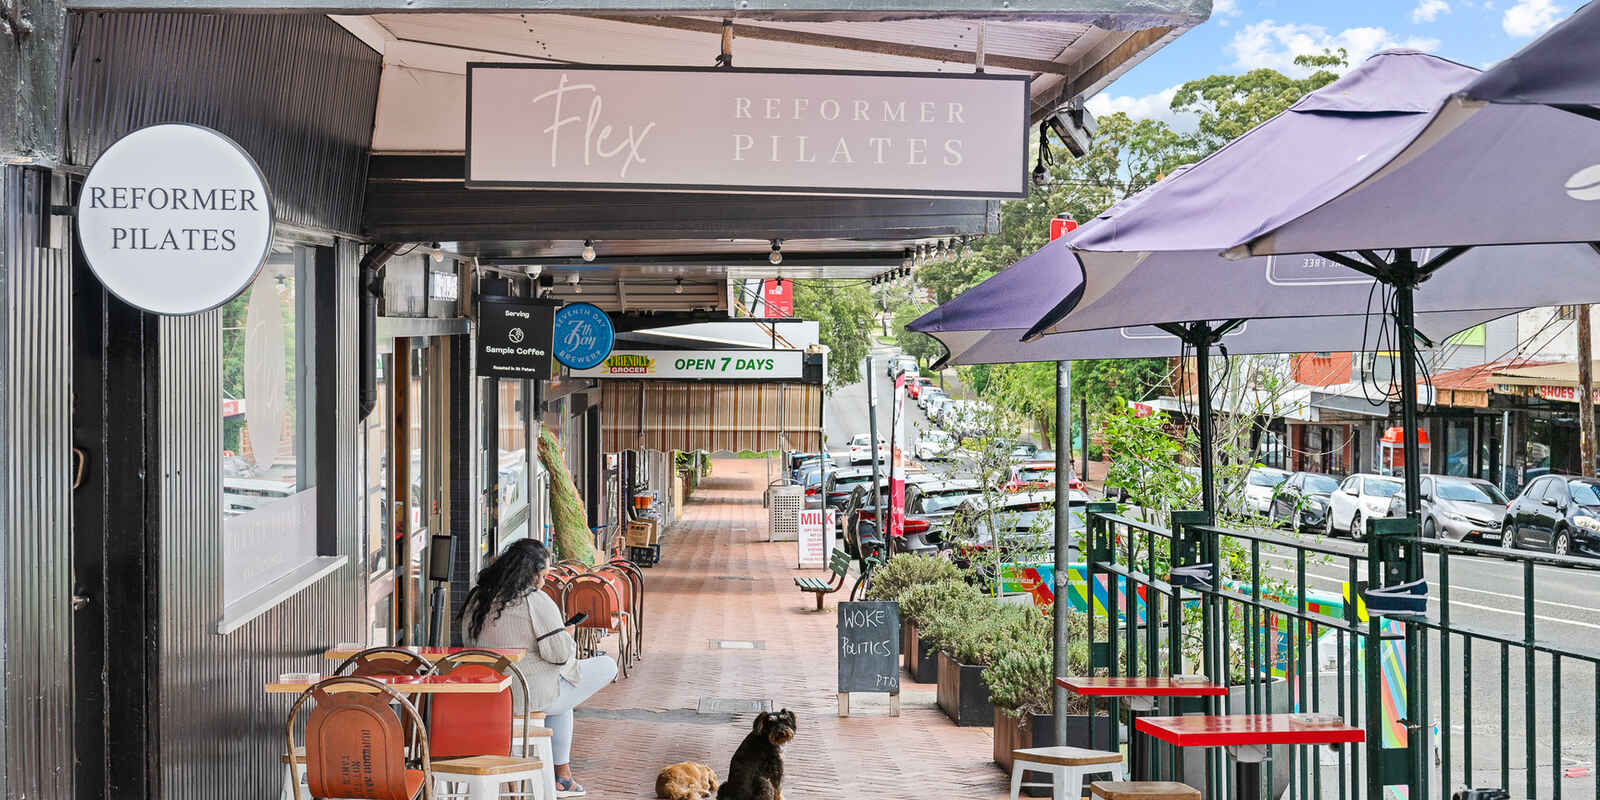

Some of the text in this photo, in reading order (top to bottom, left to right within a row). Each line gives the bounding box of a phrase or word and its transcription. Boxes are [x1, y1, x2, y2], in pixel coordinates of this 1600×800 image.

[735, 97, 966, 124] REFORMER
[533, 73, 656, 178] Flex
[732, 134, 965, 167] PILATES
[89, 186, 259, 212] REFORMER
[111, 227, 237, 251] PILATES
[505, 310, 530, 319] Serving
[486, 345, 545, 356] Sample Coffee
[559, 350, 601, 363] BREWERY
[674, 357, 775, 372] OPEN 7 DAYS
[1540, 385, 1575, 399] SHOES
[801, 512, 834, 525] MILK
[844, 607, 885, 629] WOKE
